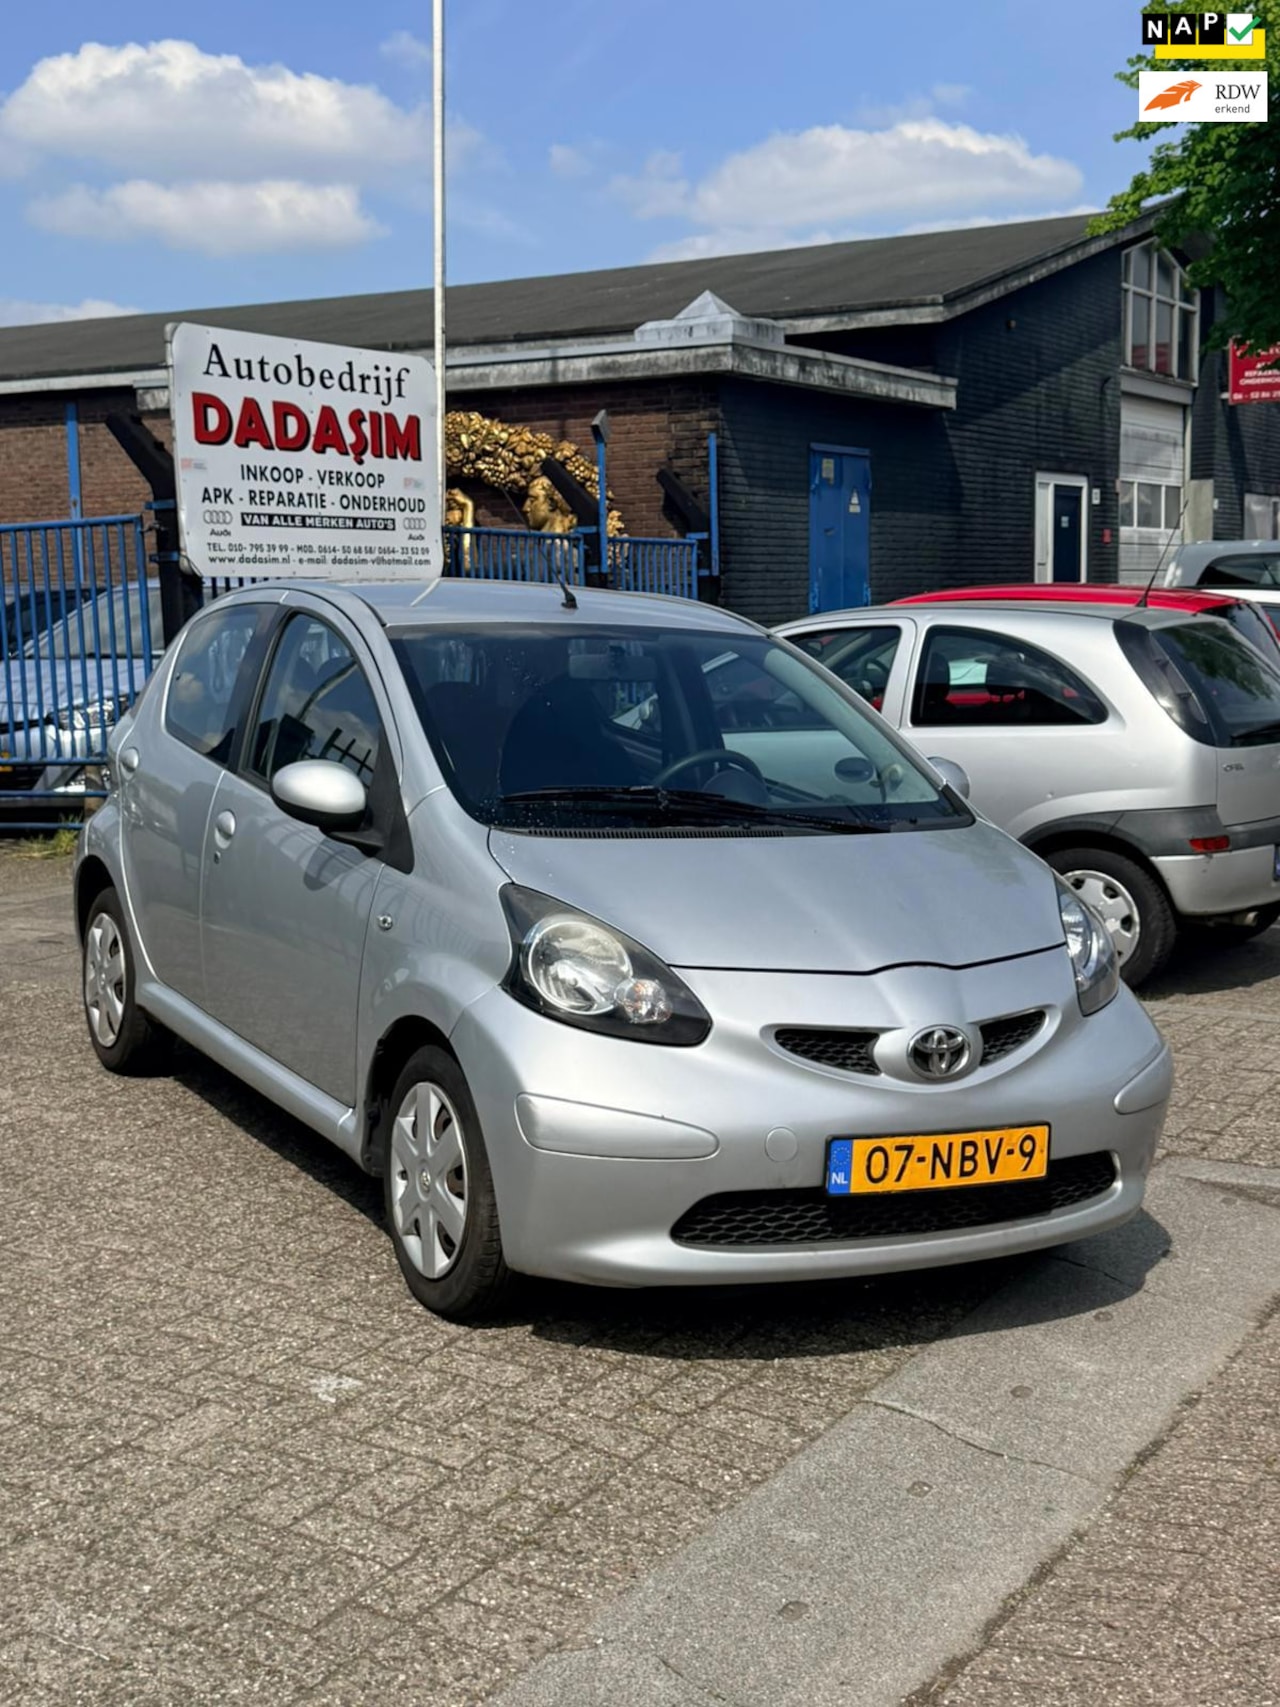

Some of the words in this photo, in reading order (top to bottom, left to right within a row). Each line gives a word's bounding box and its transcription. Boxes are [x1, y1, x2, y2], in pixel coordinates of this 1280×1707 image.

[202, 343, 410, 406] Autobedrijf
[192, 391, 422, 465] DADAŞIM
[240, 464, 303, 483] INKOOP
[317, 469, 385, 488] VERKOOP
[201, 487, 234, 505] APK
[248, 489, 326, 509] REPARATIE
[339, 494, 426, 513] ONDERHOUD
[243, 514, 269, 525] VAN
[272, 515, 303, 526] ALLE
[305, 517, 354, 529] MERKEN
[356, 519, 394, 529] AUTO'S
[207, 542, 226, 552] TEL.
[831, 1172, 848, 1185] NL
[866, 1134, 1036, 1185] 07-NBV-9
